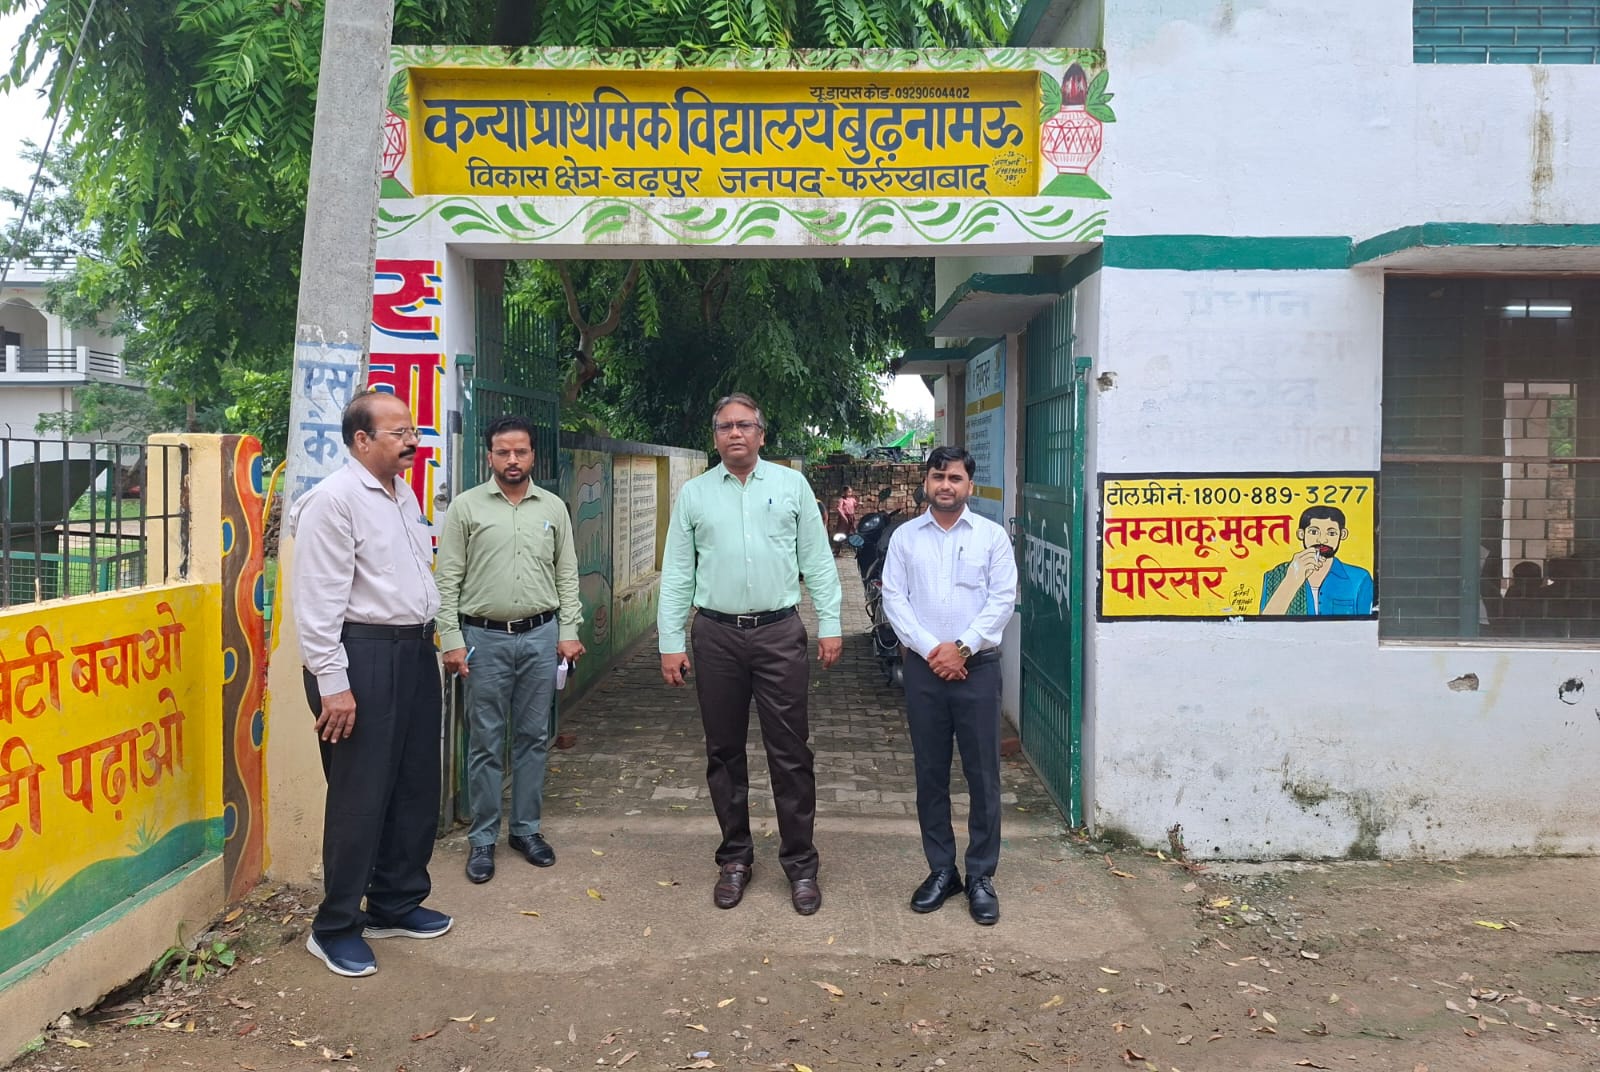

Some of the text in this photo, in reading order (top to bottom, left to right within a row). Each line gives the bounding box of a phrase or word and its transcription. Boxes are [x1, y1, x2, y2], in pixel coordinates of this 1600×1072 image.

[672, 86, 839, 156] विद्यालय
[465, 156, 550, 190] विकास
[1104, 514, 1293, 559] तम्बाकू मुक्त
[1105, 554, 1228, 601] परिसर
[71, 601, 186, 697] बचाओ
[57, 687, 186, 821] पढ़ाओ
